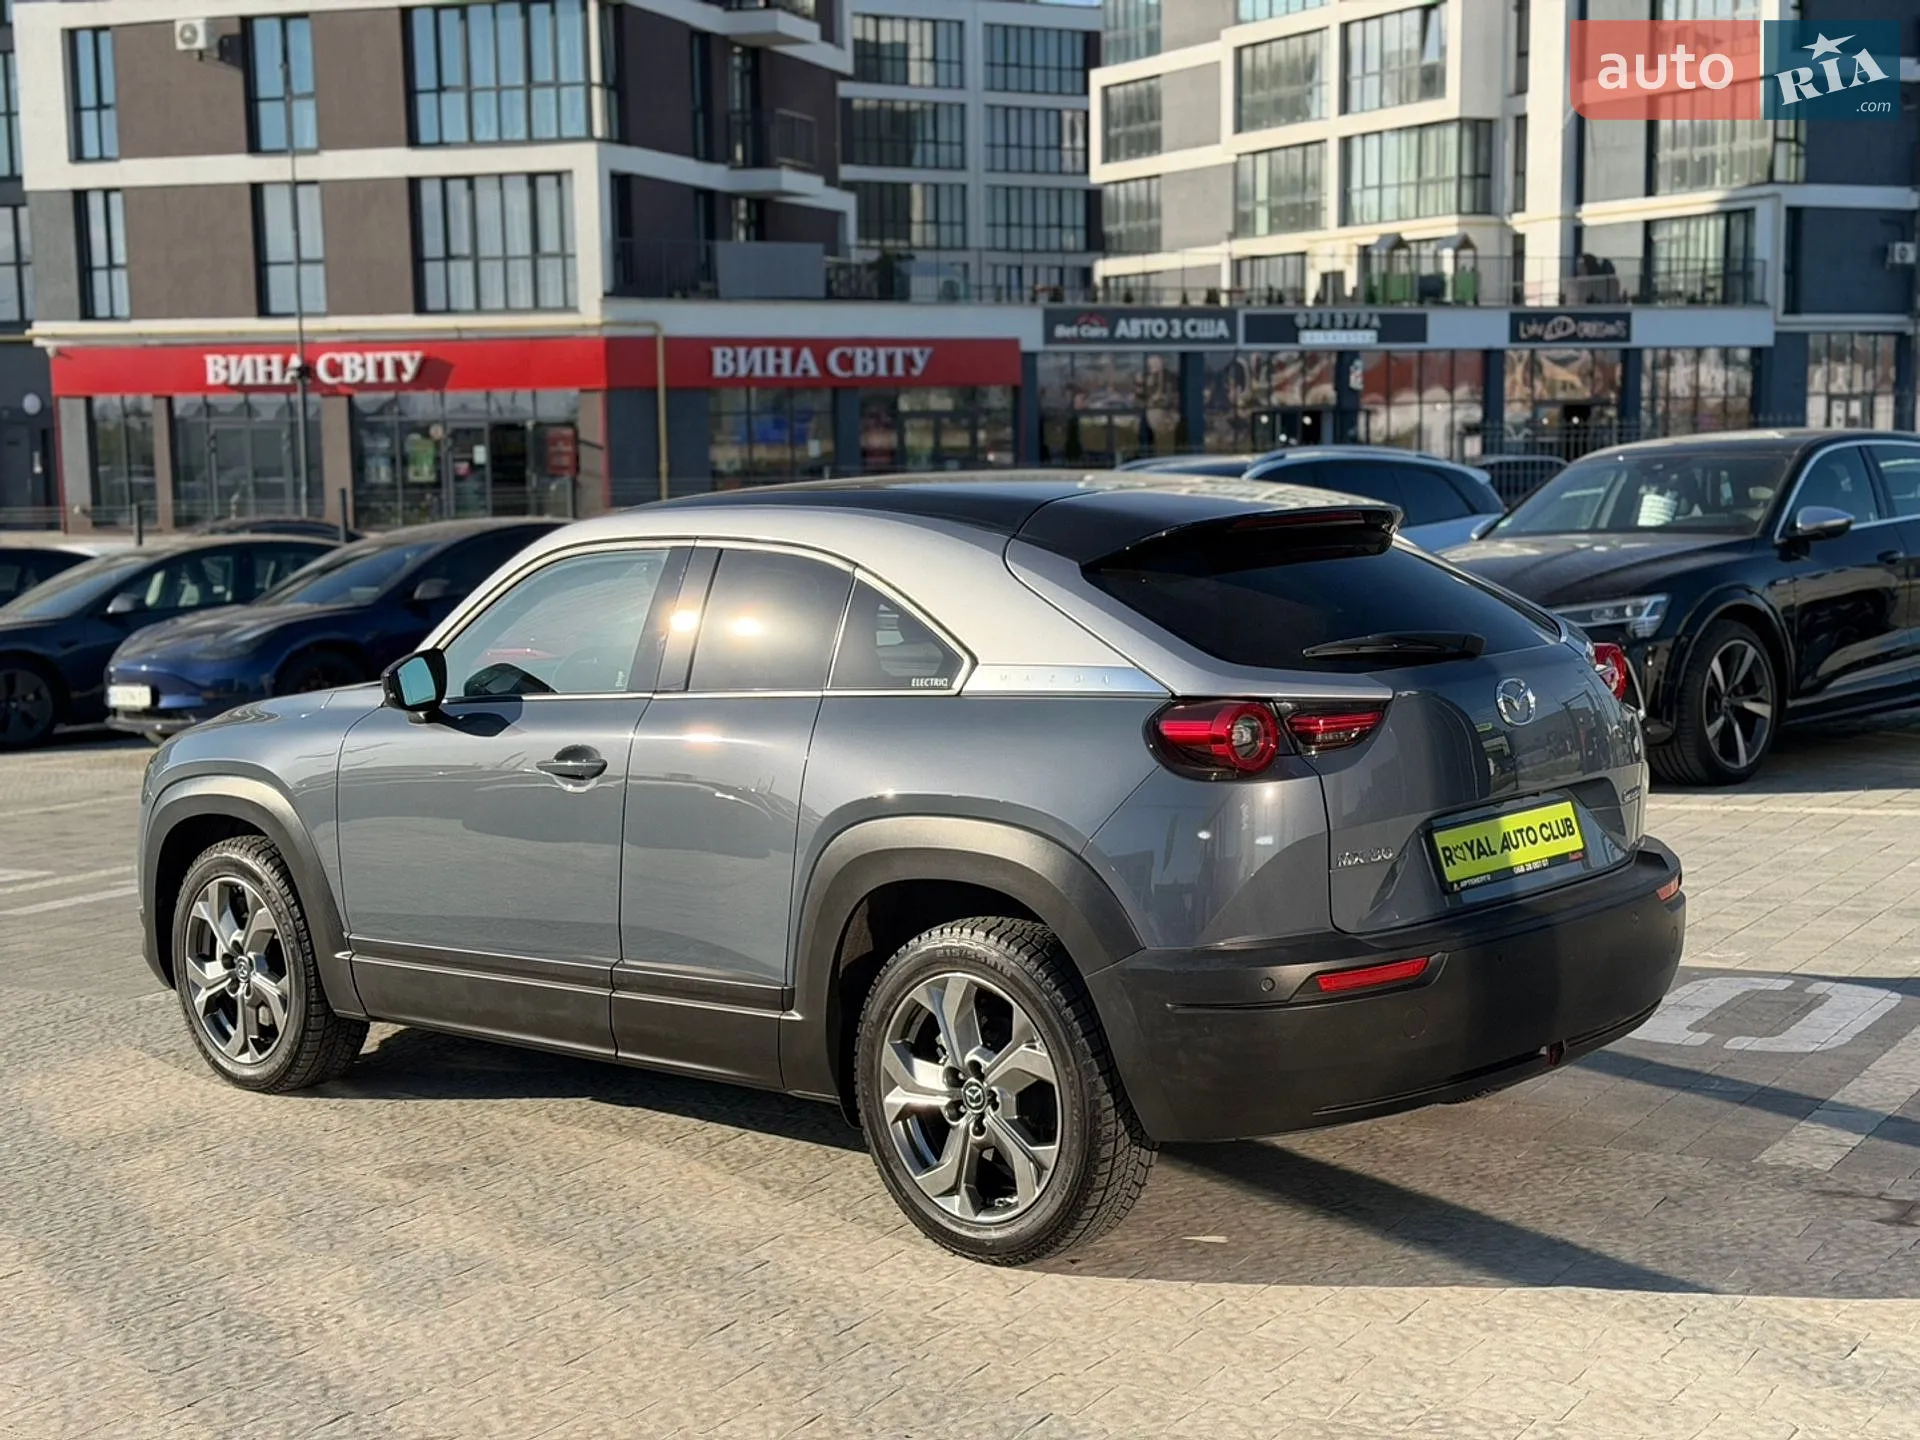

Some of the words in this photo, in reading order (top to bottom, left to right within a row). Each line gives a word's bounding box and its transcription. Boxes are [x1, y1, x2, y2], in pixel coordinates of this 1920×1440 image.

[1114, 317, 1169, 340] АВТО
[1183, 317, 1230, 340] США
[204, 353, 312, 386] ВИНА
[315, 351, 424, 384] СВІТУ
[711, 345, 821, 379] ВИНА
[826, 345, 934, 379] СВІТУ
[1500, 824, 1538, 854] AUTO
[1538, 817, 1576, 843] CLUB
